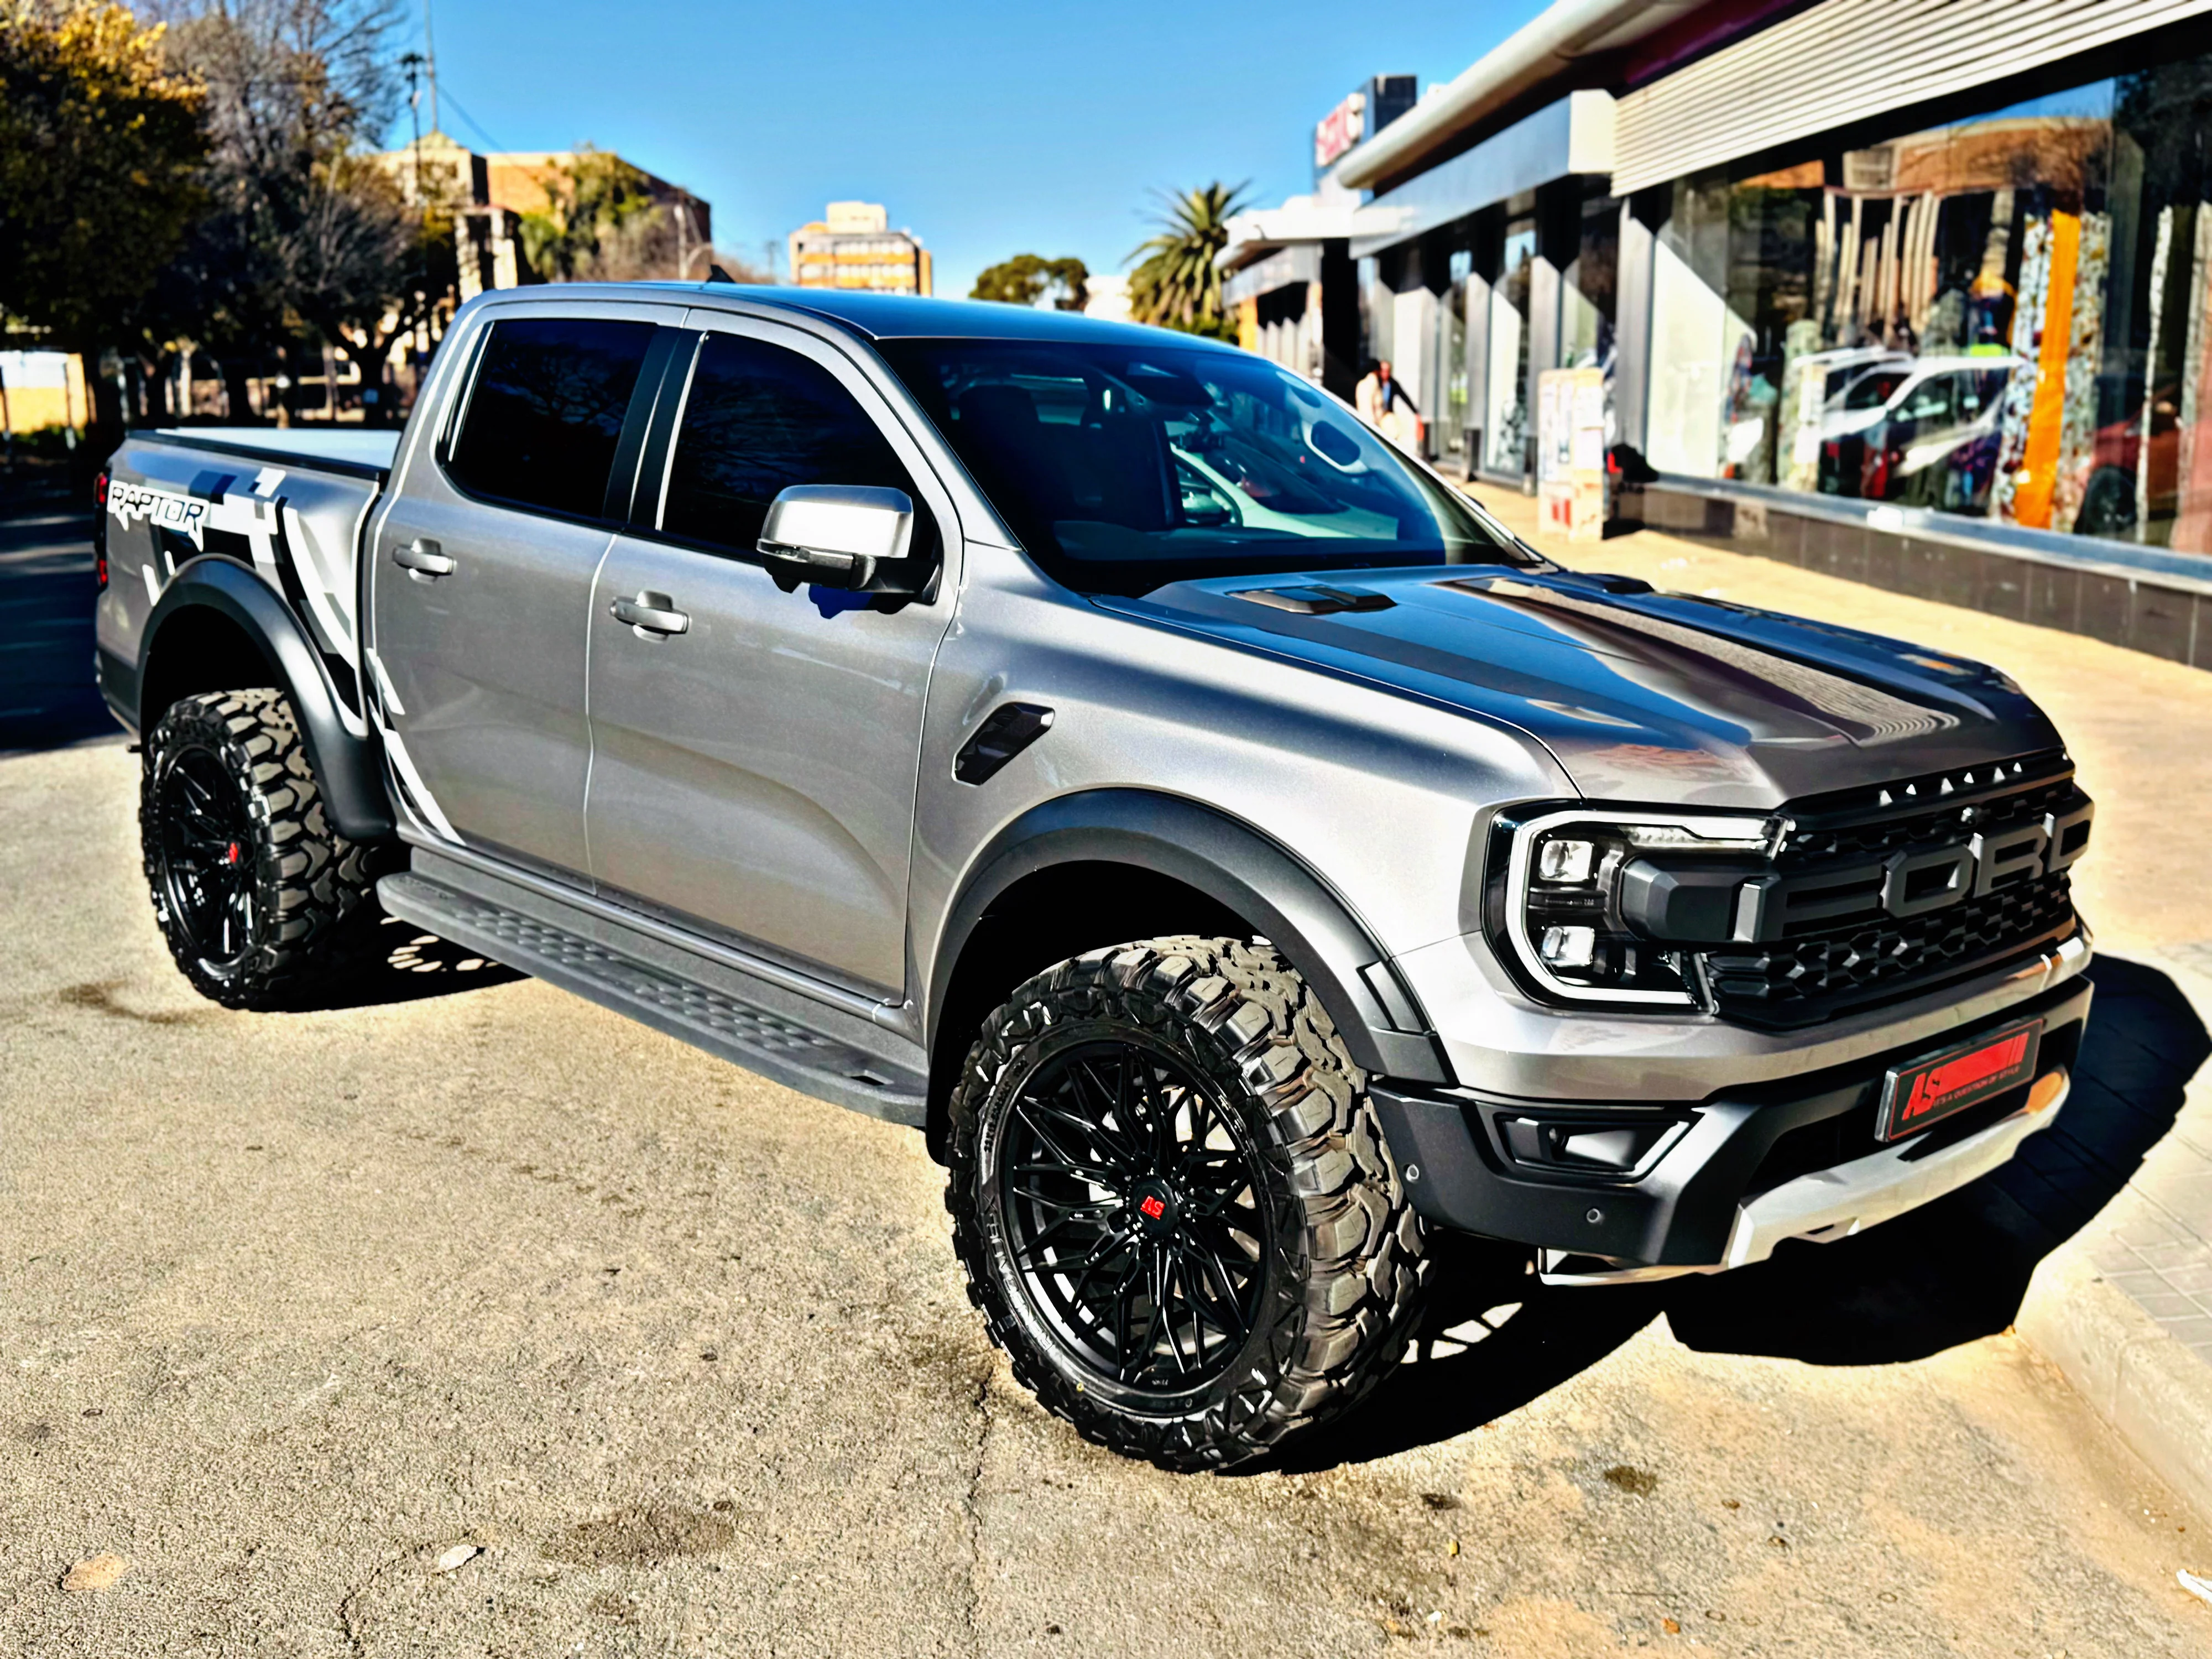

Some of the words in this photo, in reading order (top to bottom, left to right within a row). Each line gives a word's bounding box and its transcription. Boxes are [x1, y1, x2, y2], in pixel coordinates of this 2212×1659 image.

[108, 480, 210, 551] RAPTOR
[1734, 799, 2094, 942] FORD
[1902, 1068, 1943, 1120] AS
